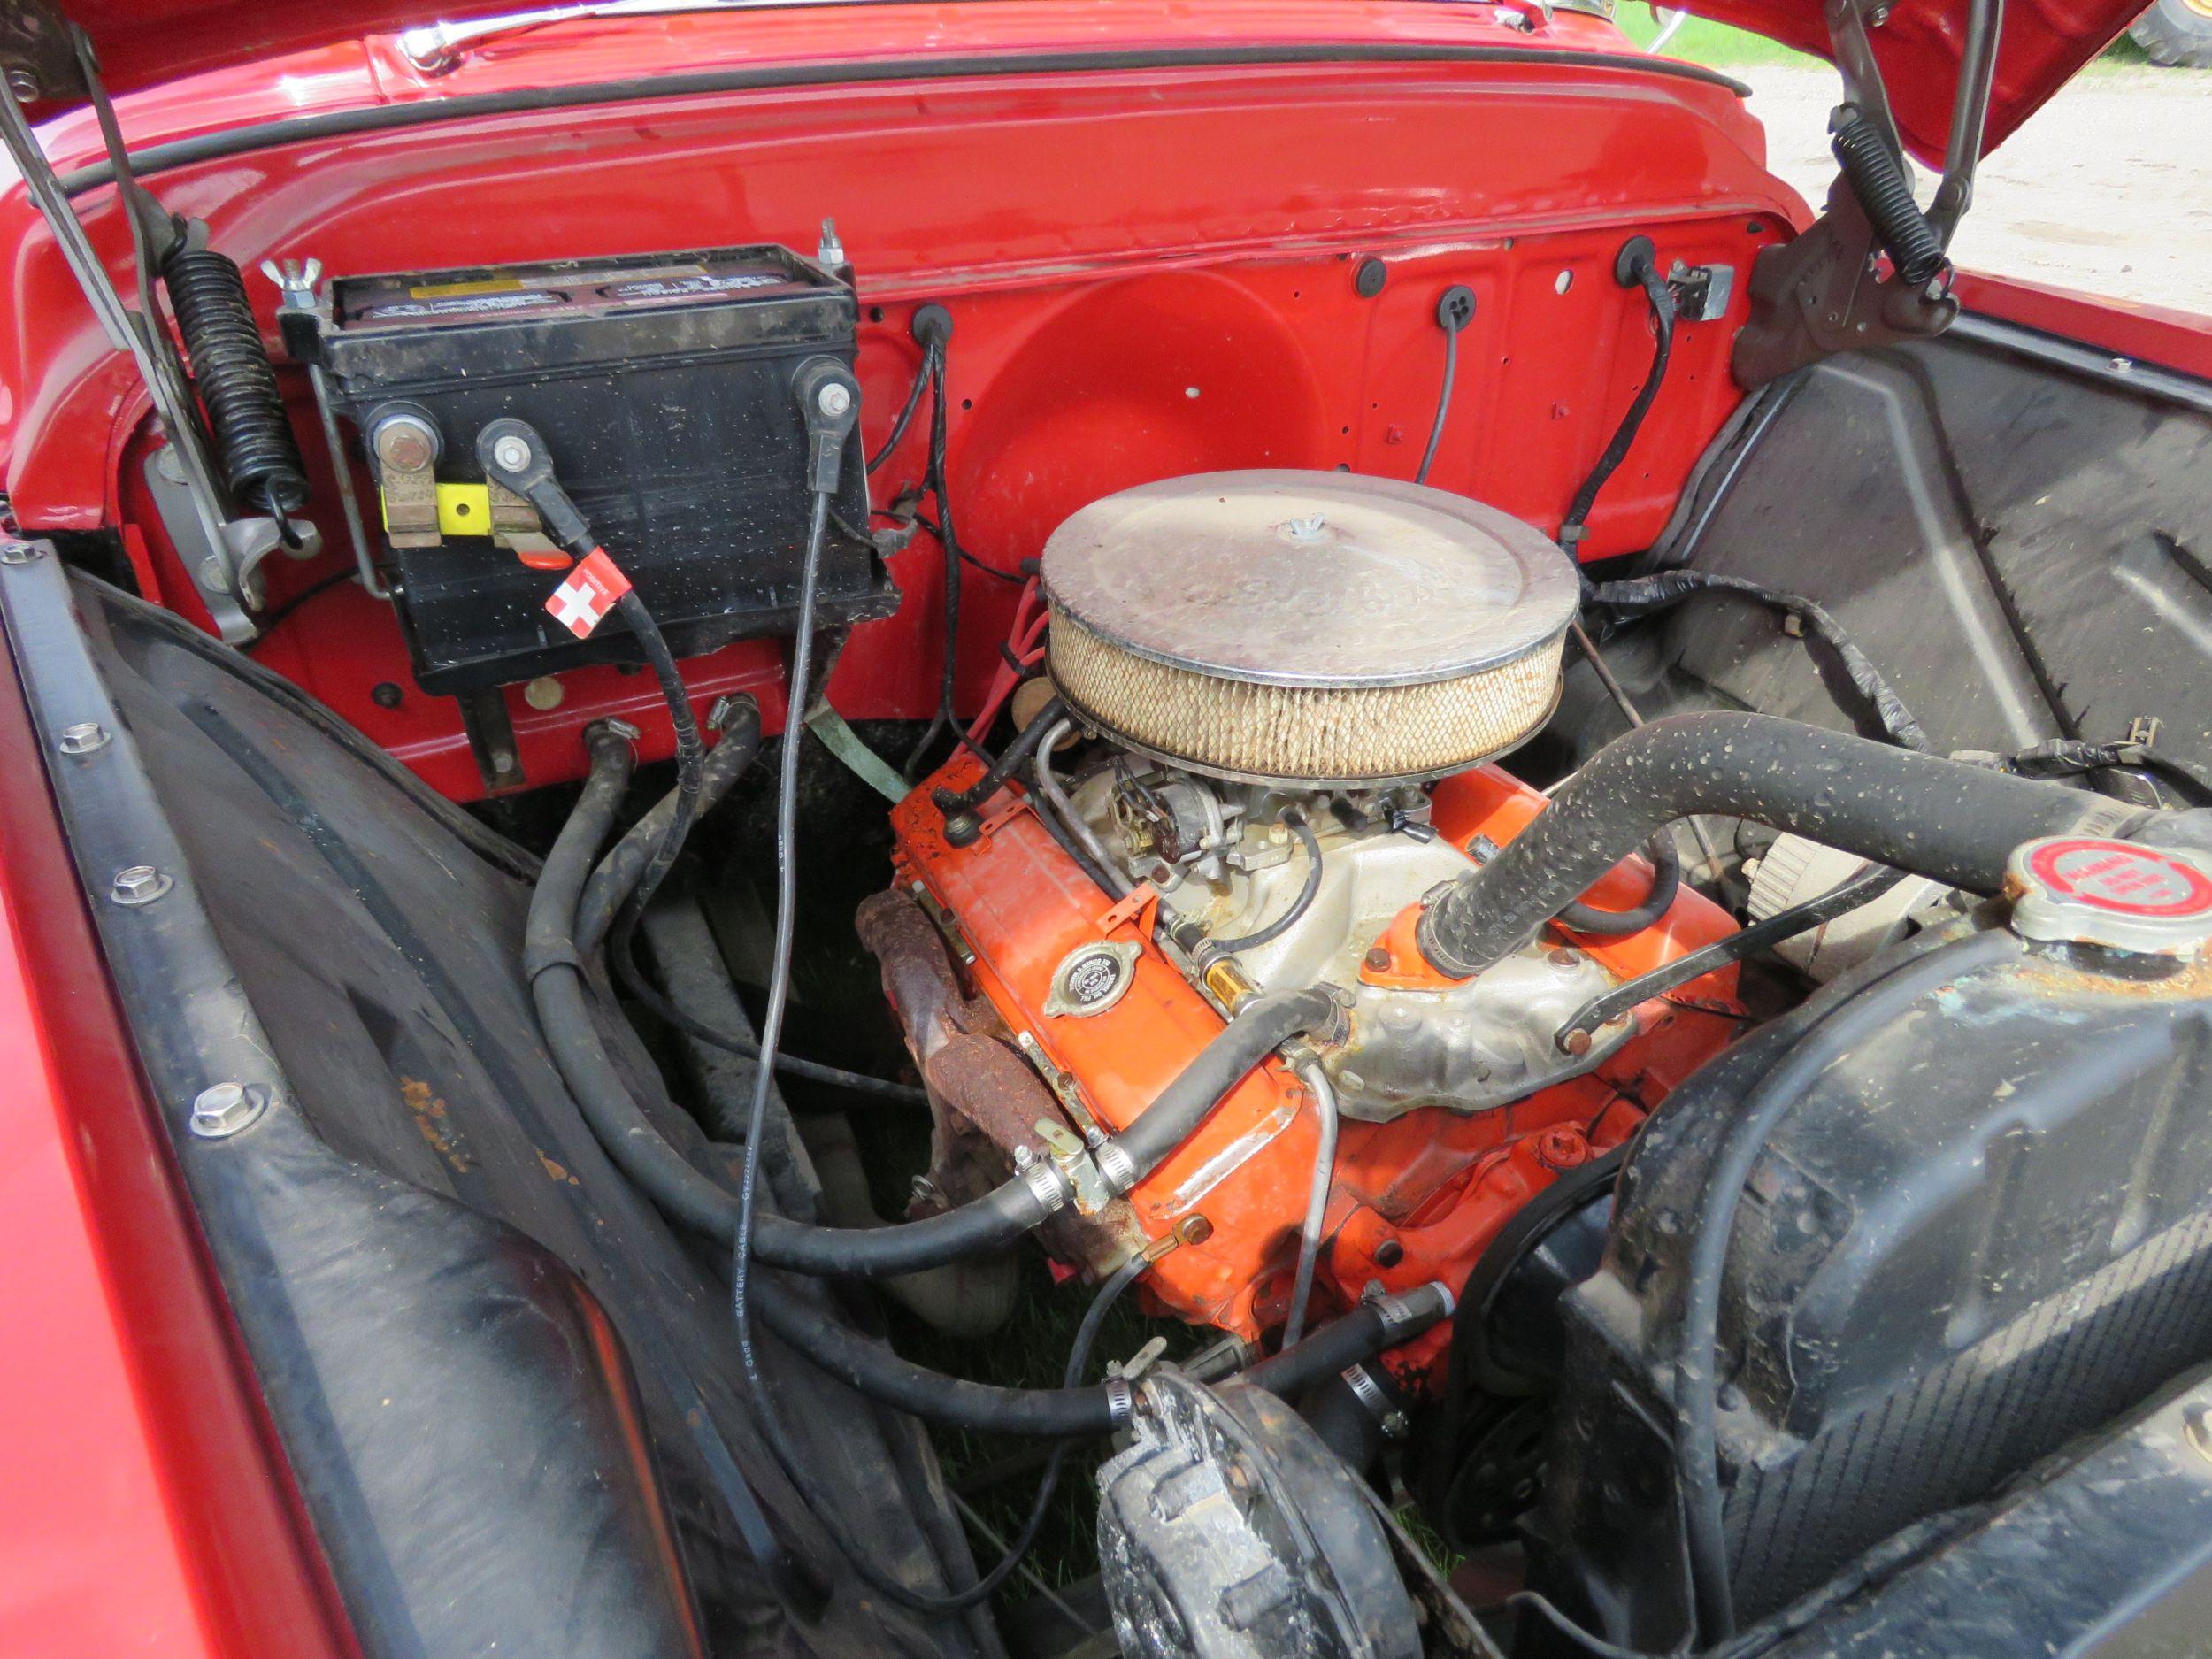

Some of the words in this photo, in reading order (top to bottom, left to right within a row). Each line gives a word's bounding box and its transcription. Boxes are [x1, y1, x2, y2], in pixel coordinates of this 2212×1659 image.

[582, 568, 610, 595] POSITIVE
[736, 1223, 748, 1260] CABLE
[734, 1267, 745, 1317] BATTERY
